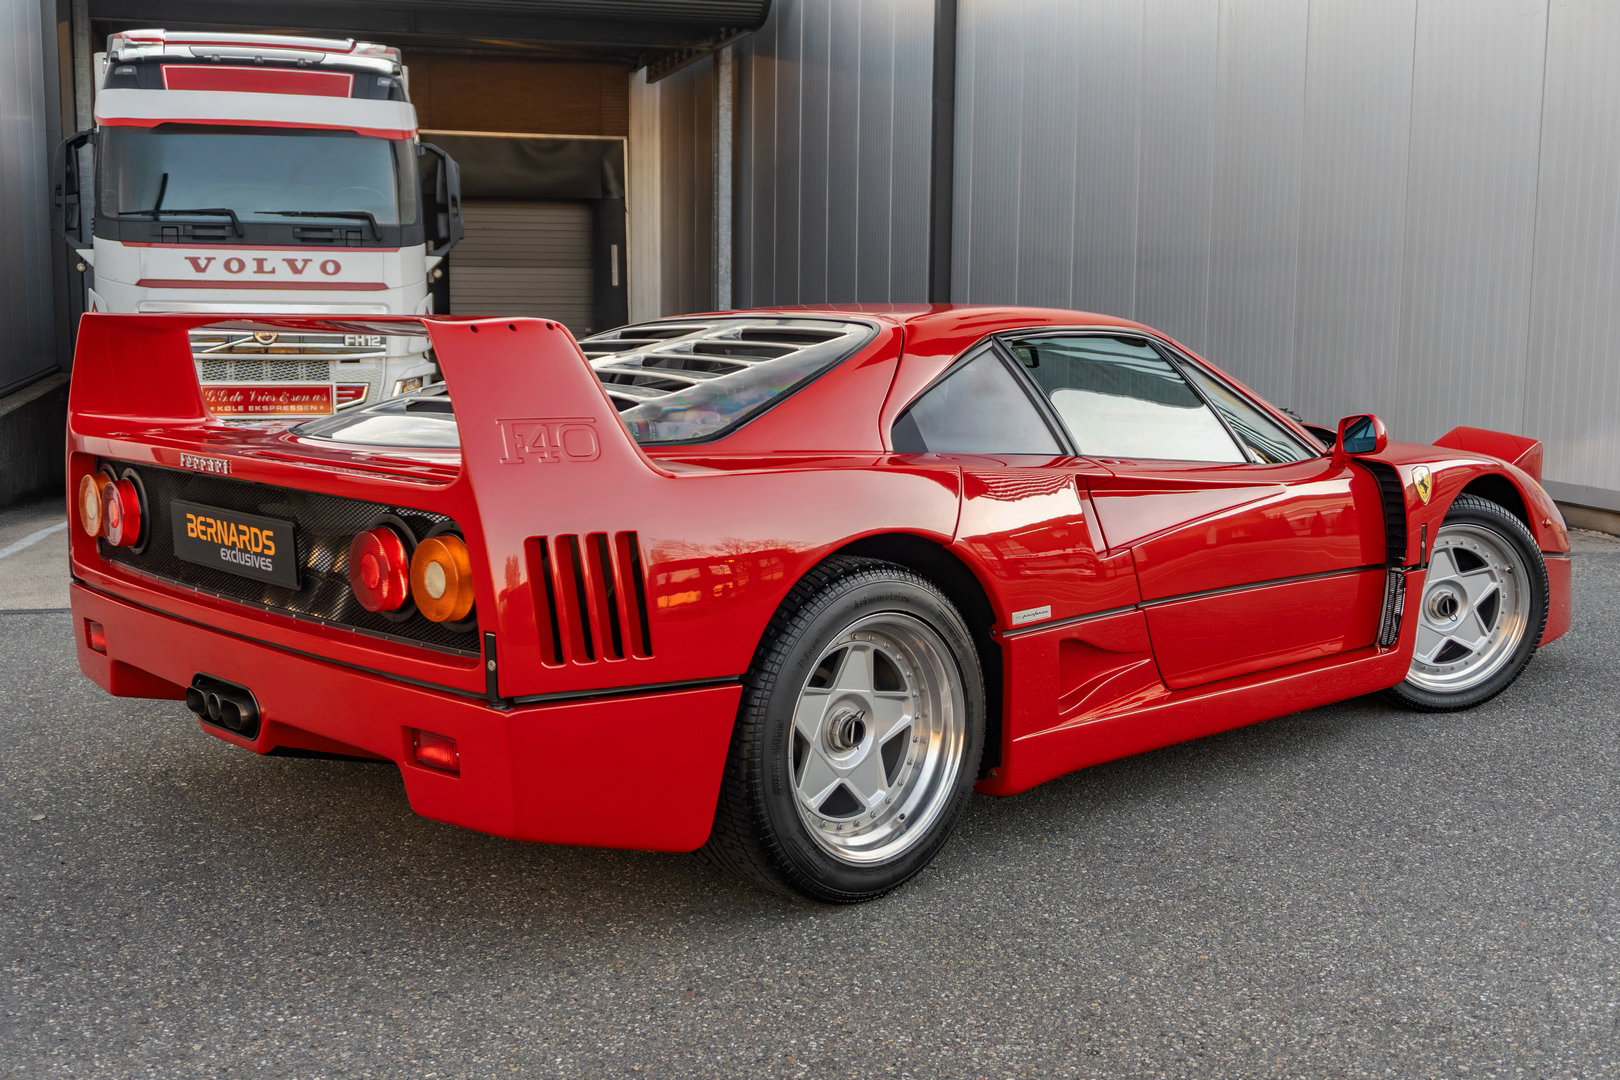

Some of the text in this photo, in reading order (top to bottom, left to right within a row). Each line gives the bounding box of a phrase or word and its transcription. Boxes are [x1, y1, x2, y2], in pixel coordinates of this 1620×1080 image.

[184, 256, 342, 276] VOLVO
[344, 334, 381, 346] FH12
[249, 390, 276, 402] Vries
[279, 391, 290, 404] &
[495, 416, 602, 464] F40
[180, 453, 232, 474] Ferrari
[186, 513, 276, 556] BERNARDS
[220, 548, 273, 571] exclusives
